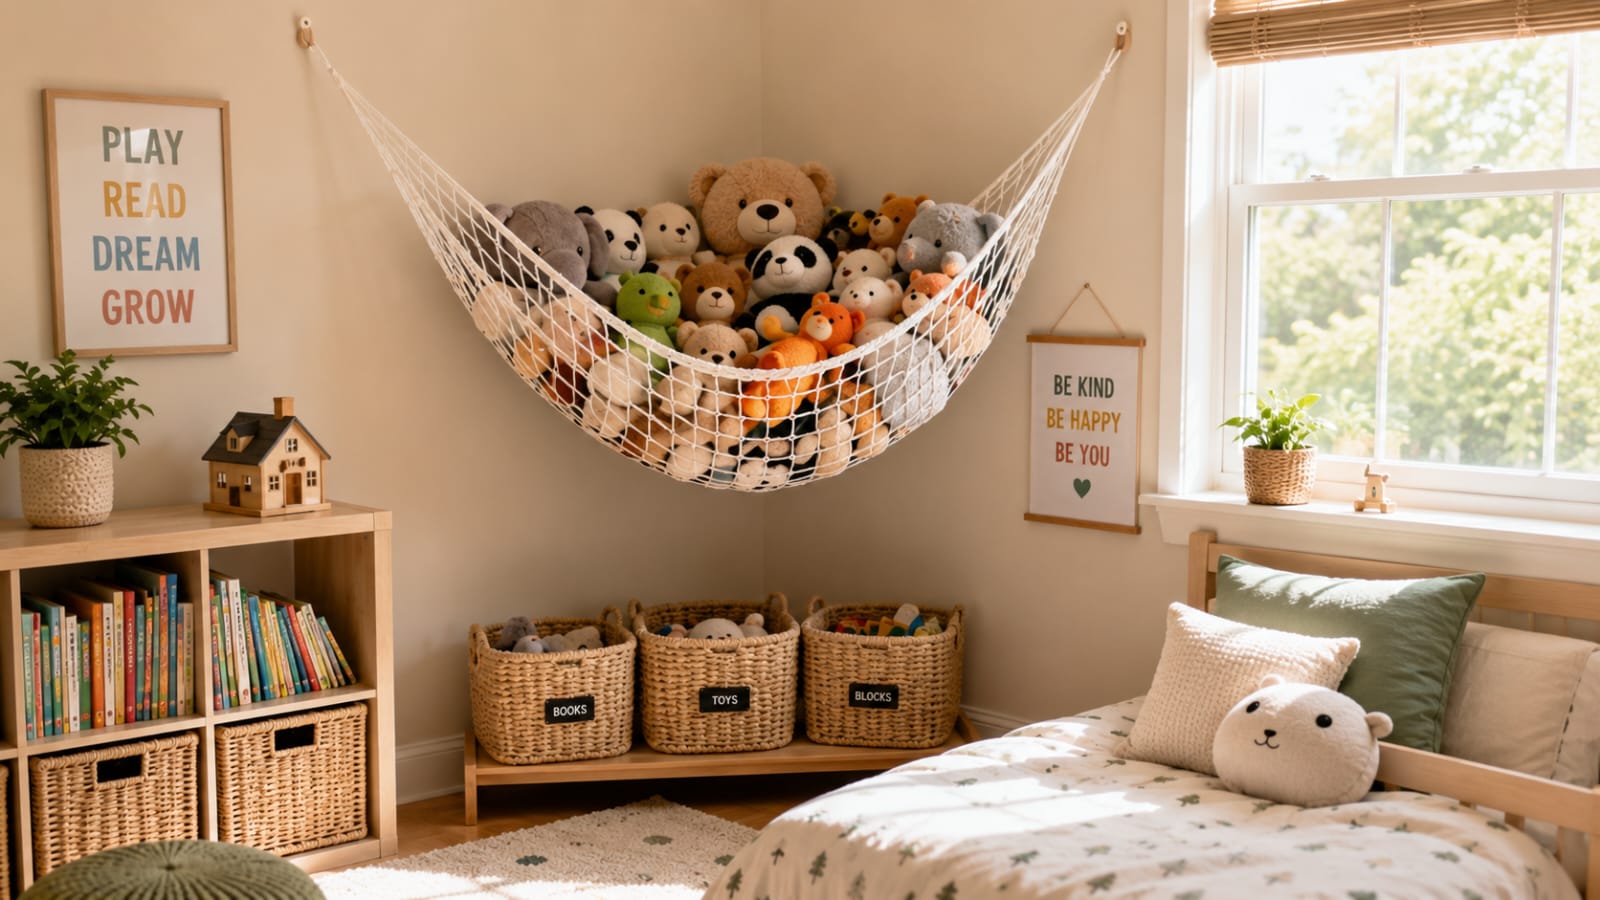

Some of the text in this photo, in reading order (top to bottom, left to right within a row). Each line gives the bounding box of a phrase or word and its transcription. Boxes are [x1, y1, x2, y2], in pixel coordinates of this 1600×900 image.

[102, 125, 184, 165] PLAY
[103, 181, 186, 218] READ
[92, 235, 200, 271] DREAM
[101, 289, 195, 325] GROW
[1054, 374, 1114, 399] BE KIND
[1047, 407, 1121, 433] BE HAPPY
[1055, 442, 1110, 467] BE YOU
[711, 694, 738, 705] TOYS
[854, 690, 892, 703] BLOCKS
[553, 704, 587, 717] BOOKS
